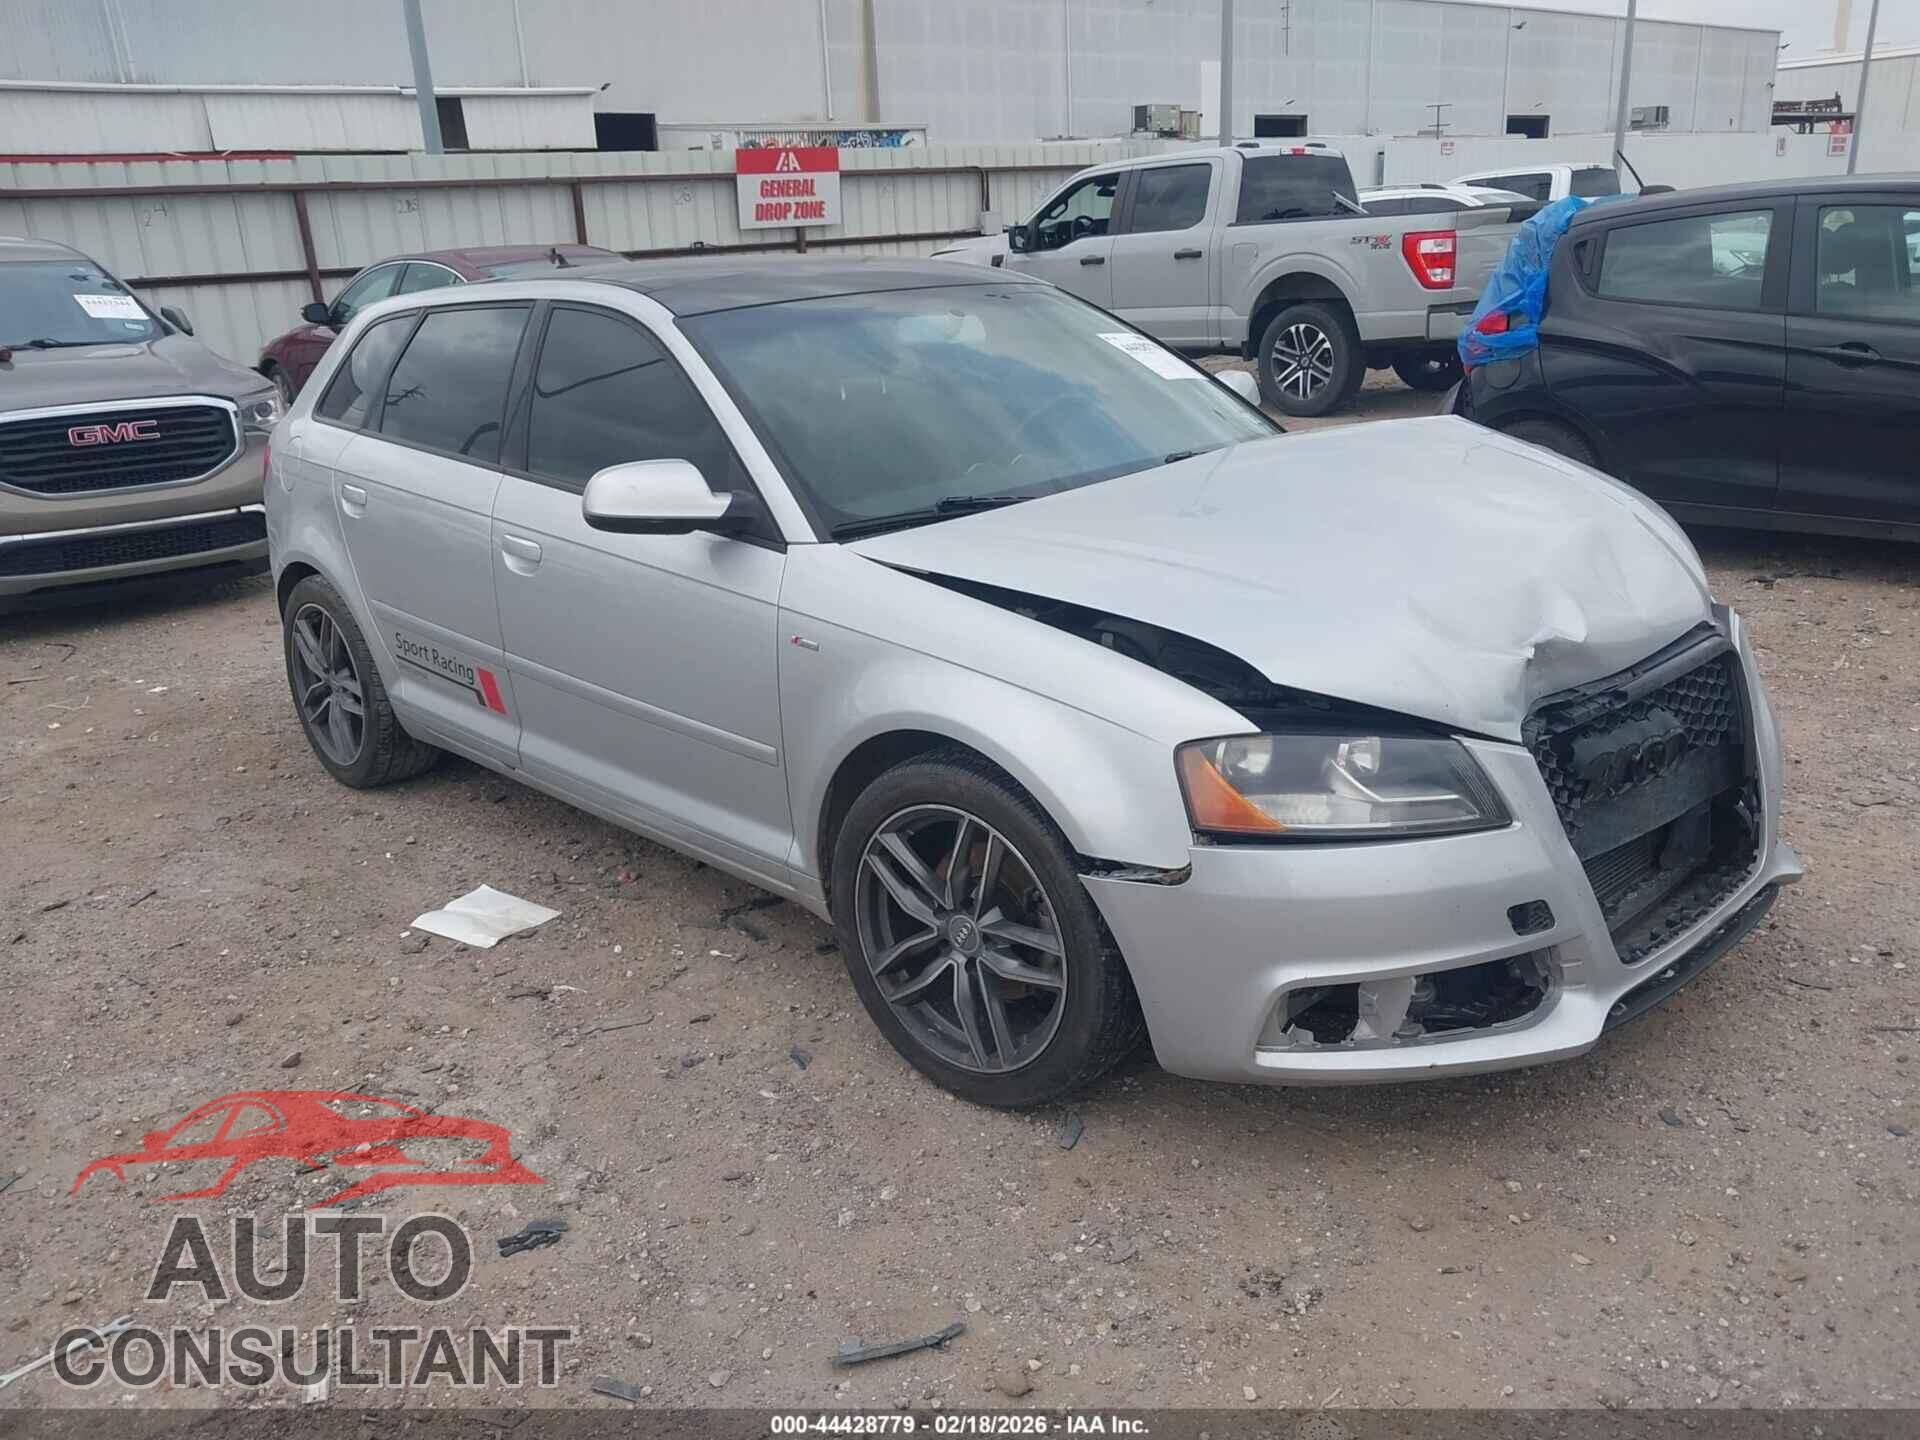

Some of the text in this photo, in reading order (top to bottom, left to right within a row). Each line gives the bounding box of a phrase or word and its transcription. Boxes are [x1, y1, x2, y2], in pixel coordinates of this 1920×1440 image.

[760, 178, 816, 198] GENERAL
[755, 201, 825, 221] DROP ZONE
[68, 420, 160, 446] GMC
[395, 632, 475, 685] Sport Racing
